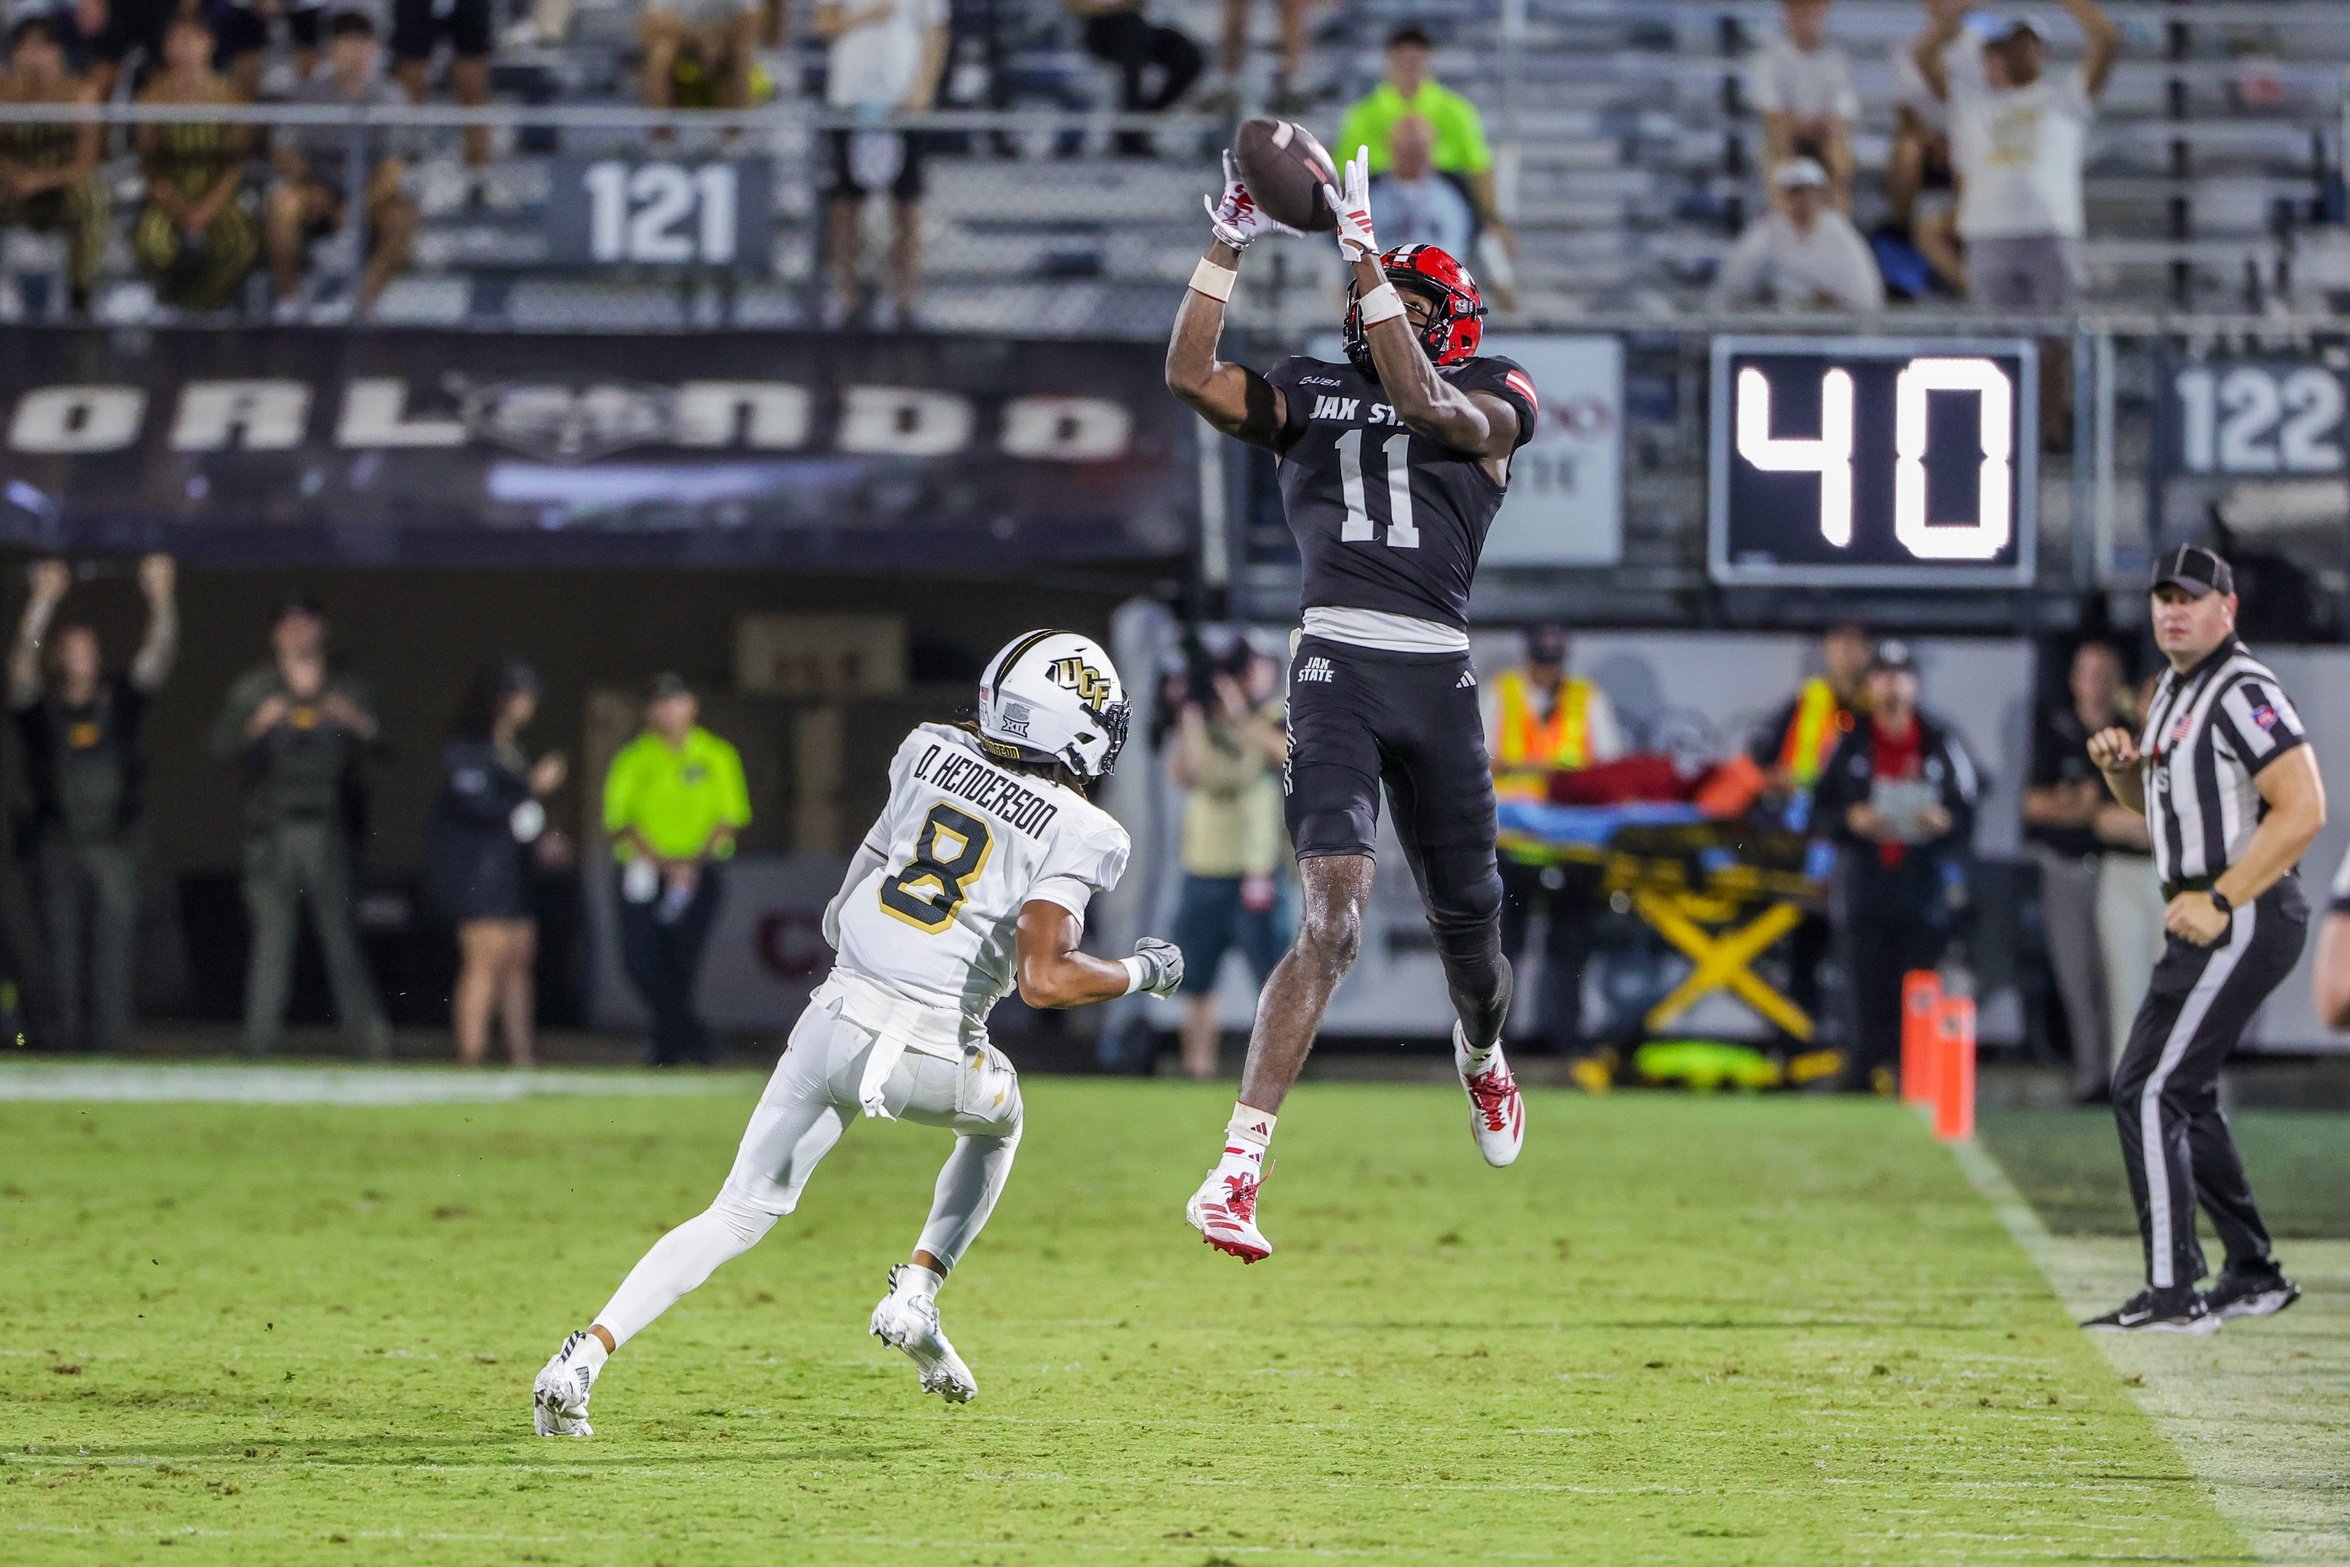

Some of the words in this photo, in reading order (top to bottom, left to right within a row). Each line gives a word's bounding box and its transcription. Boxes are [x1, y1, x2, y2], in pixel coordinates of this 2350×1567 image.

[583, 161, 738, 264] 121
[1309, 395, 1360, 420] JAX
[2175, 366, 2346, 473] 122
[1335, 428, 1419, 549] 11
[1737, 357, 2011, 560] 40
[1050, 656, 1111, 711] UCF
[1297, 669, 1335, 683] STATE
[1304, 656, 1331, 670] JAX
[913, 743, 941, 781] D.
[930, 752, 1057, 840] HENDERSON
[877, 800, 994, 935] 8
